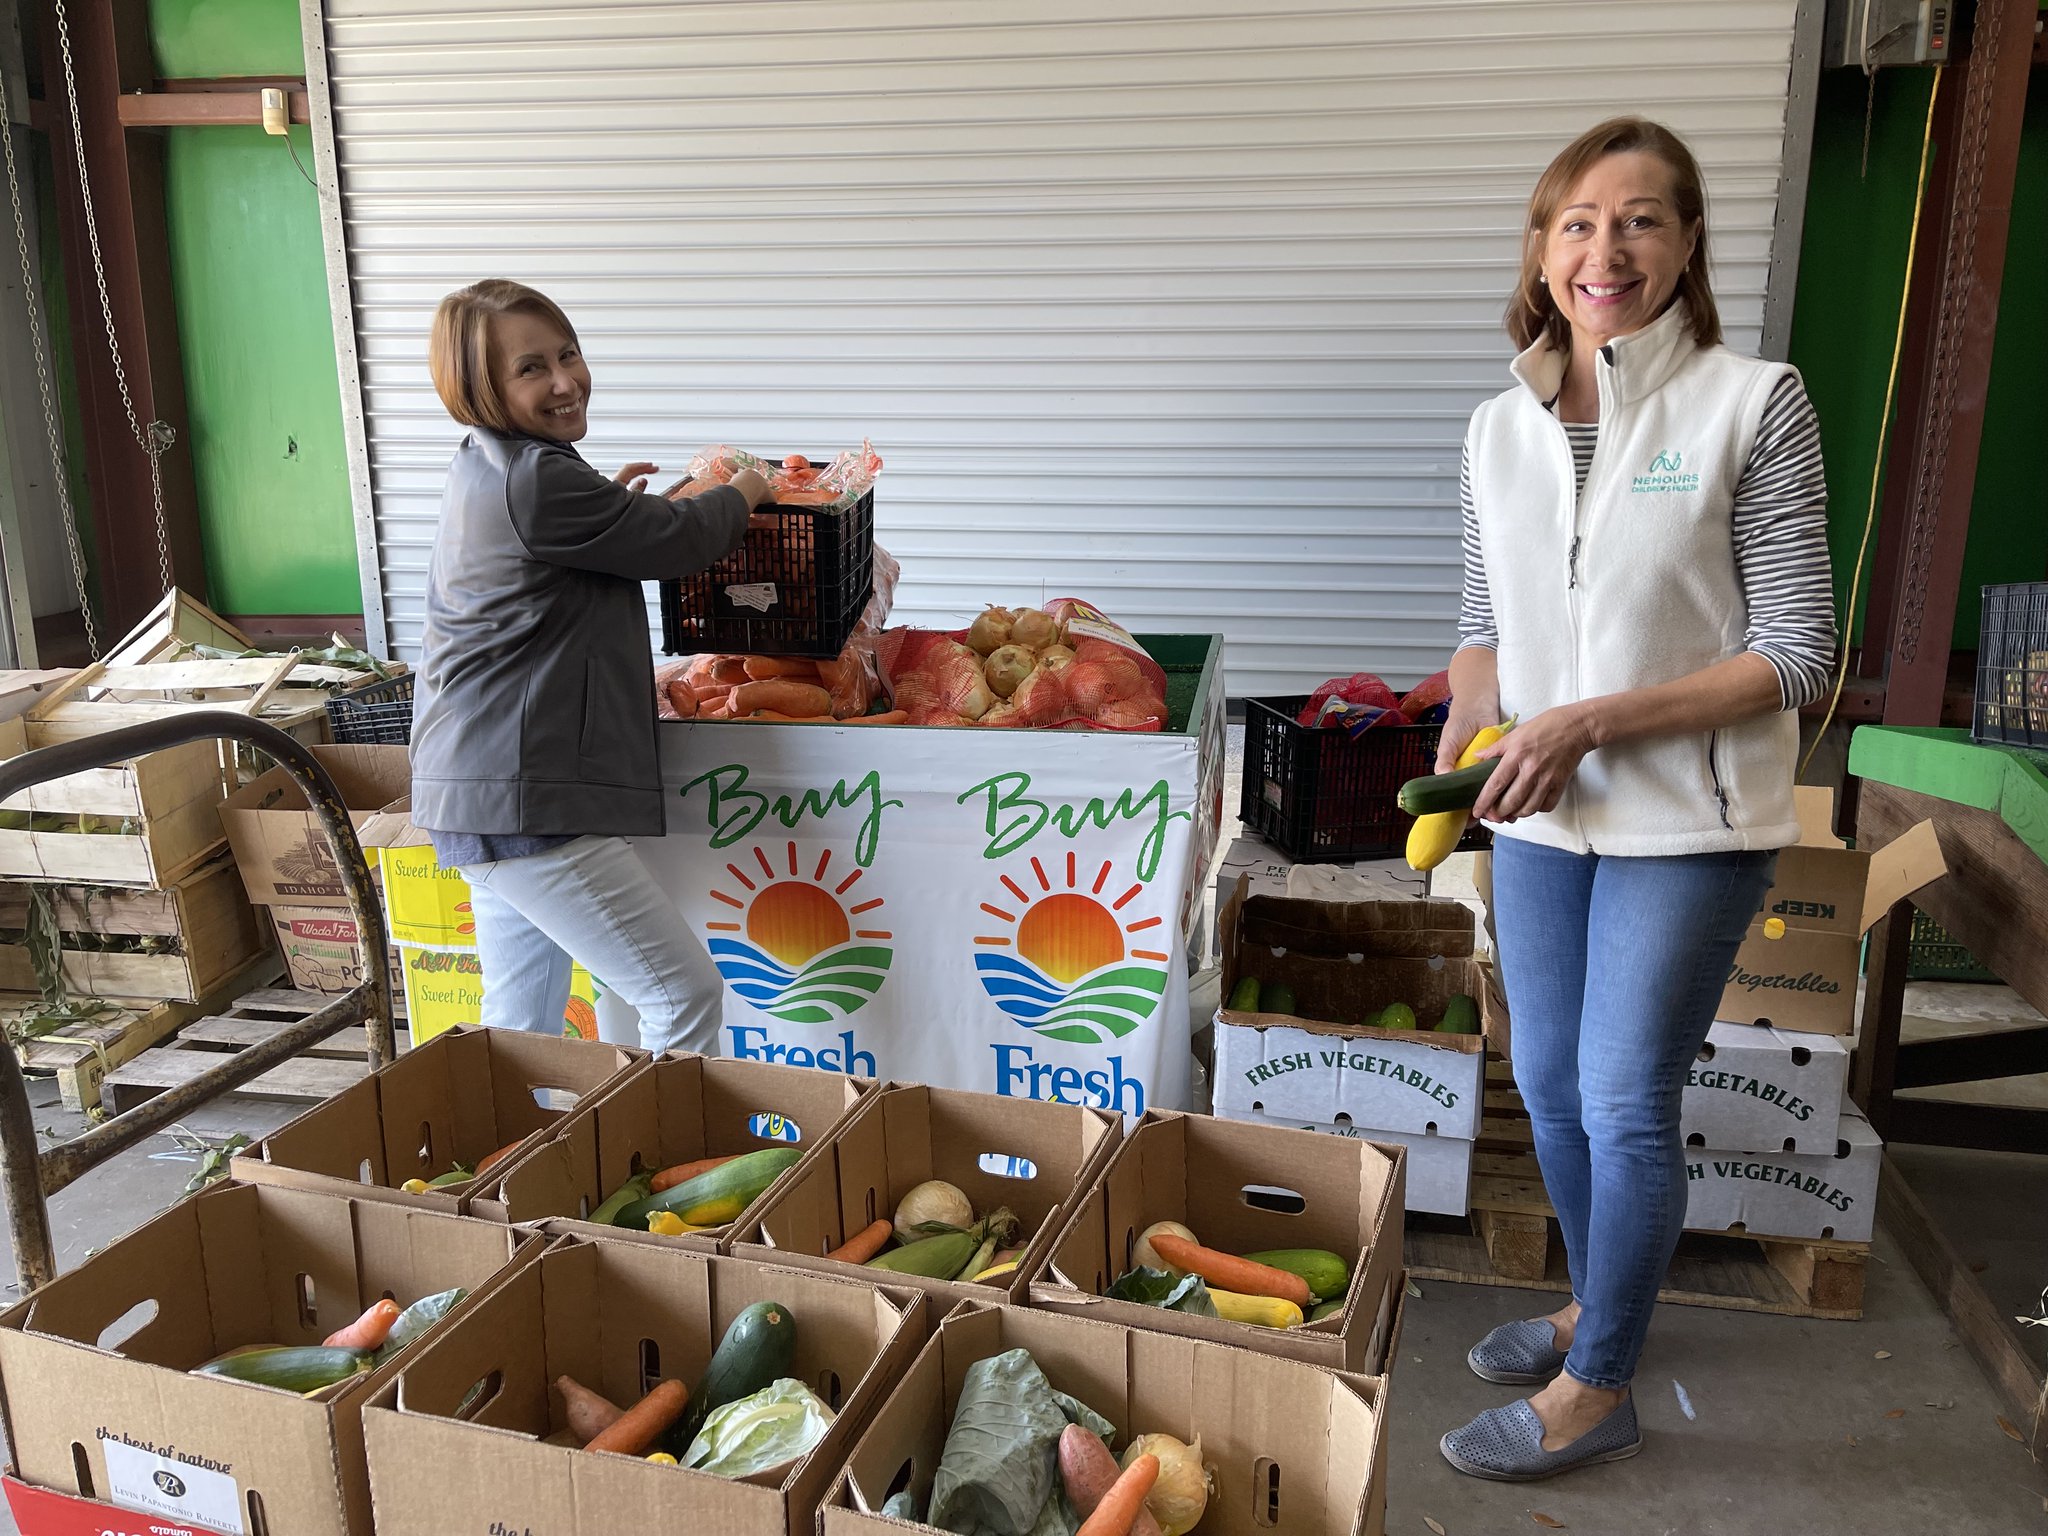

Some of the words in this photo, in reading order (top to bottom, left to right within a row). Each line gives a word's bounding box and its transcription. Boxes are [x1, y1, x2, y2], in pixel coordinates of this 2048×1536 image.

[1633, 473, 1699, 485] NEMOURS
[680, 764, 903, 867] Buy
[957, 771, 1191, 882] Buy
[395, 859, 428, 878] Sweet
[431, 862, 462, 880] Pota
[298, 922, 335, 937] Wada
[1772, 900, 1835, 919] KEEP
[421, 985, 454, 1004] Sweet
[726, 1026, 876, 1077] Fresh
[990, 1044, 1144, 1118] Fresh
[1244, 1052, 1313, 1087] FRESH
[1319, 1051, 1460, 1109] VEGETABLES
[1685, 1070, 1815, 1121] EGETABLES
[1713, 1162, 1854, 1212] VEGETABLES
[157, 1444, 175, 1459] of
[115, 1485, 139, 1500] LEVIN
[141, 1494, 193, 1518] PAPANTONIO
[196, 1512, 238, 1531] RAFFERTY
